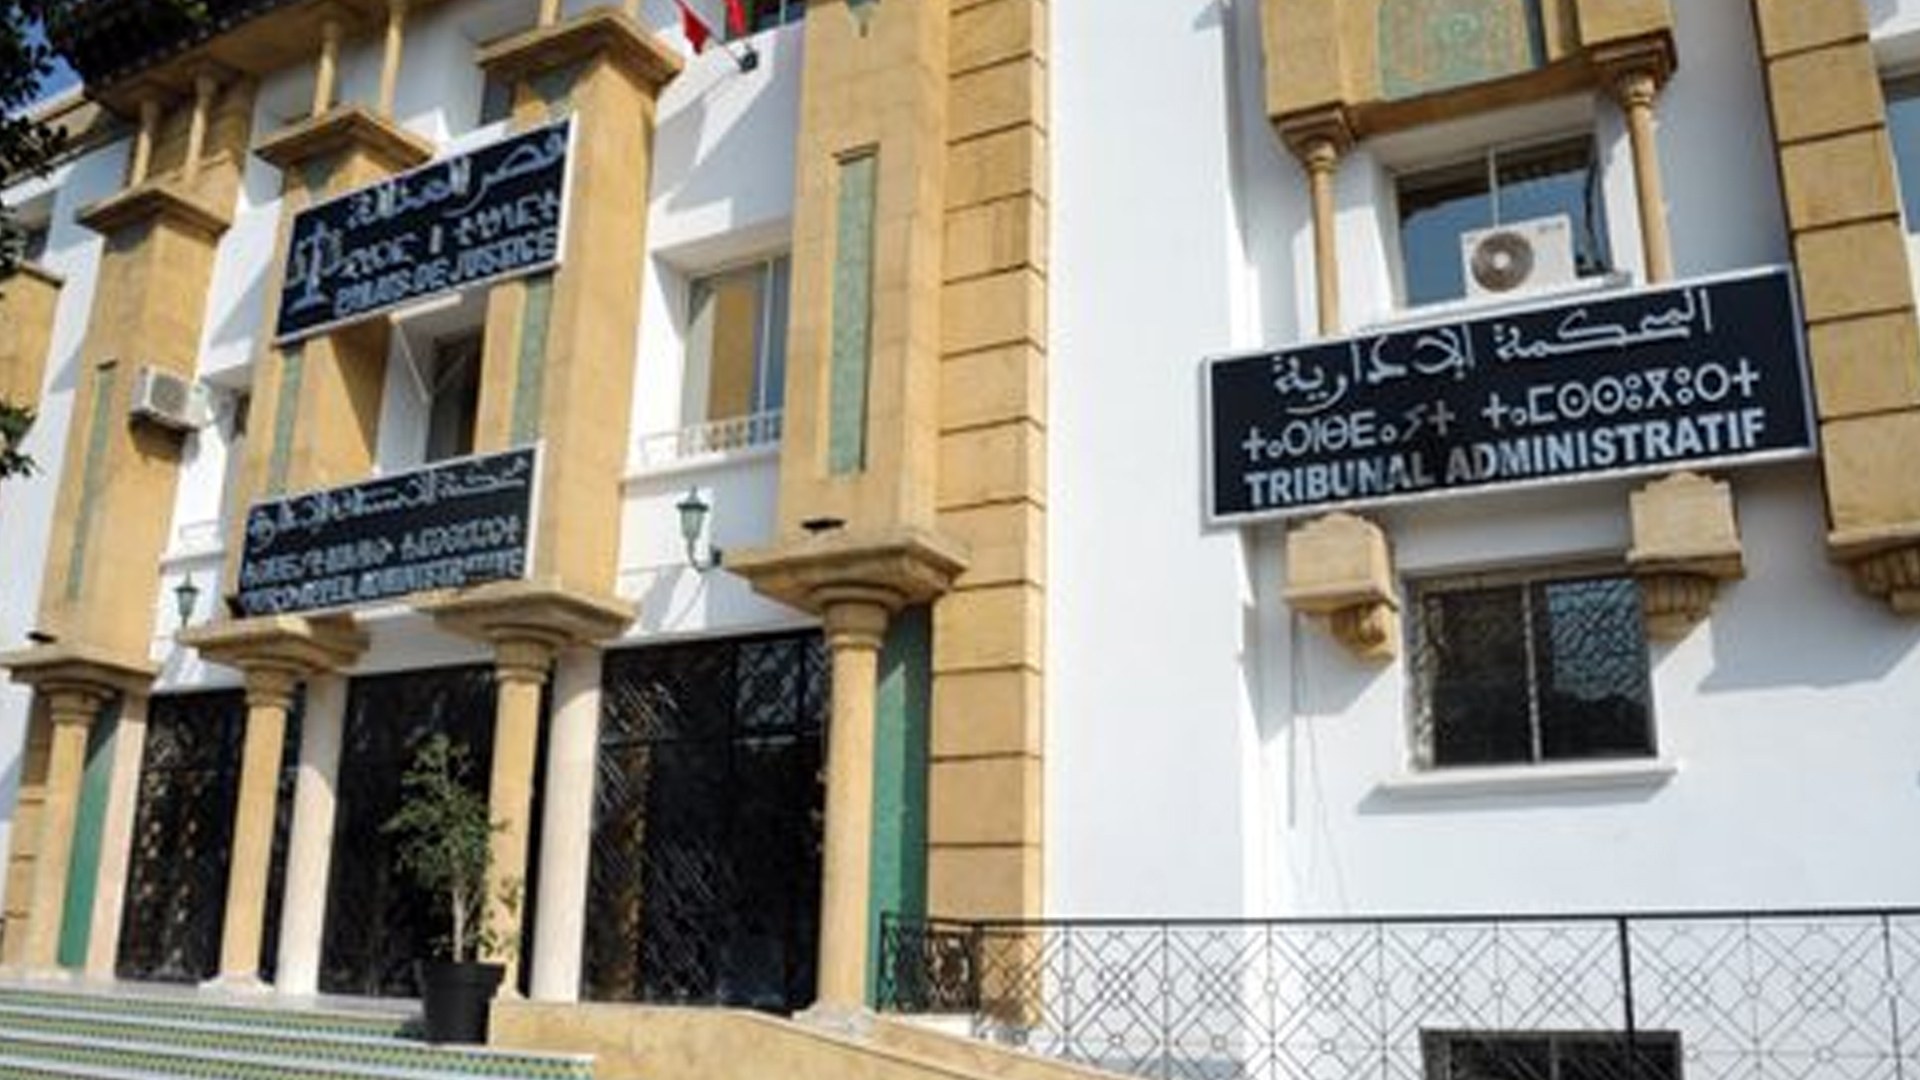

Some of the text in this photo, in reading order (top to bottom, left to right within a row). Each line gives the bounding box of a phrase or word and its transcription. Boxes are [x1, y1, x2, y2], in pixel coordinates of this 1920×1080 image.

[413, 256, 450, 293] DE
[449, 227, 558, 283] JUSTICE
[1272, 288, 1713, 416] المحكمة الإدارية
[1244, 407, 1767, 507] TRIBUNAL ADMINISTRATIF
